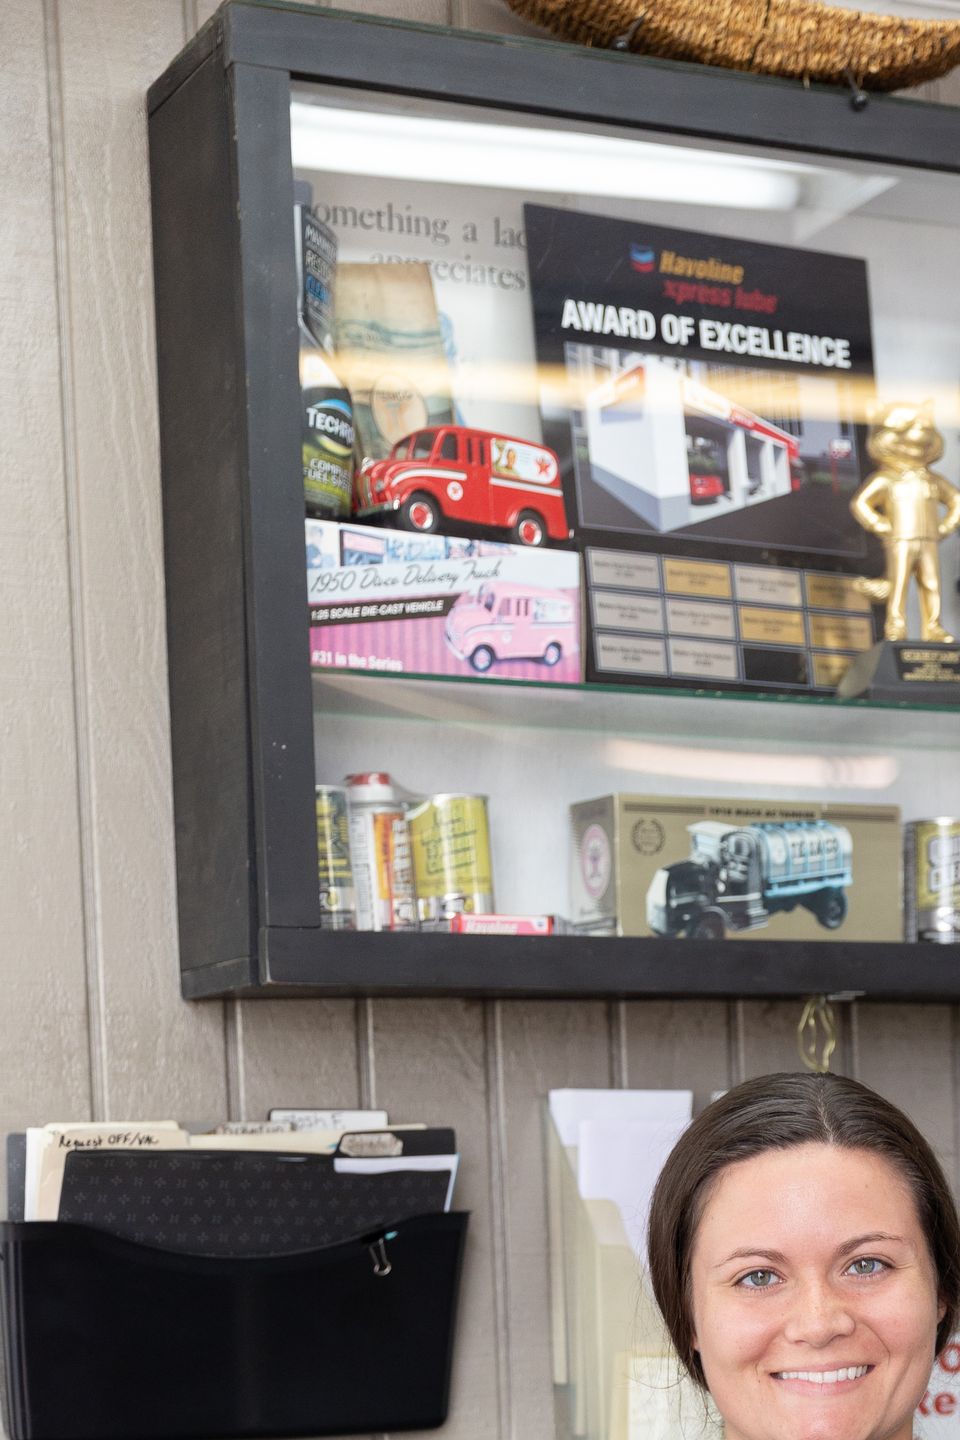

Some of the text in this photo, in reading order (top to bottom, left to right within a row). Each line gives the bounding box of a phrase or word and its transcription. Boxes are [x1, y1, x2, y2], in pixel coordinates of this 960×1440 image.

[312, 202, 449, 246] omething
[462, 221, 479, 243] a
[659, 250, 744, 285] Havoline
[561, 299, 852, 369] AWARD OF EXCELLENCE
[310, 569, 357, 593] 1950
[403, 562, 459, 589] Delivery
[462, 560, 502, 584] Truck
[330, 604, 360, 619] SCALE
[361, 602, 404, 618] DIE-CAST
[405, 599, 444, 616] VEHICLE
[368, 655, 403, 672] Series
[58, 1134, 102, 1150] Request
